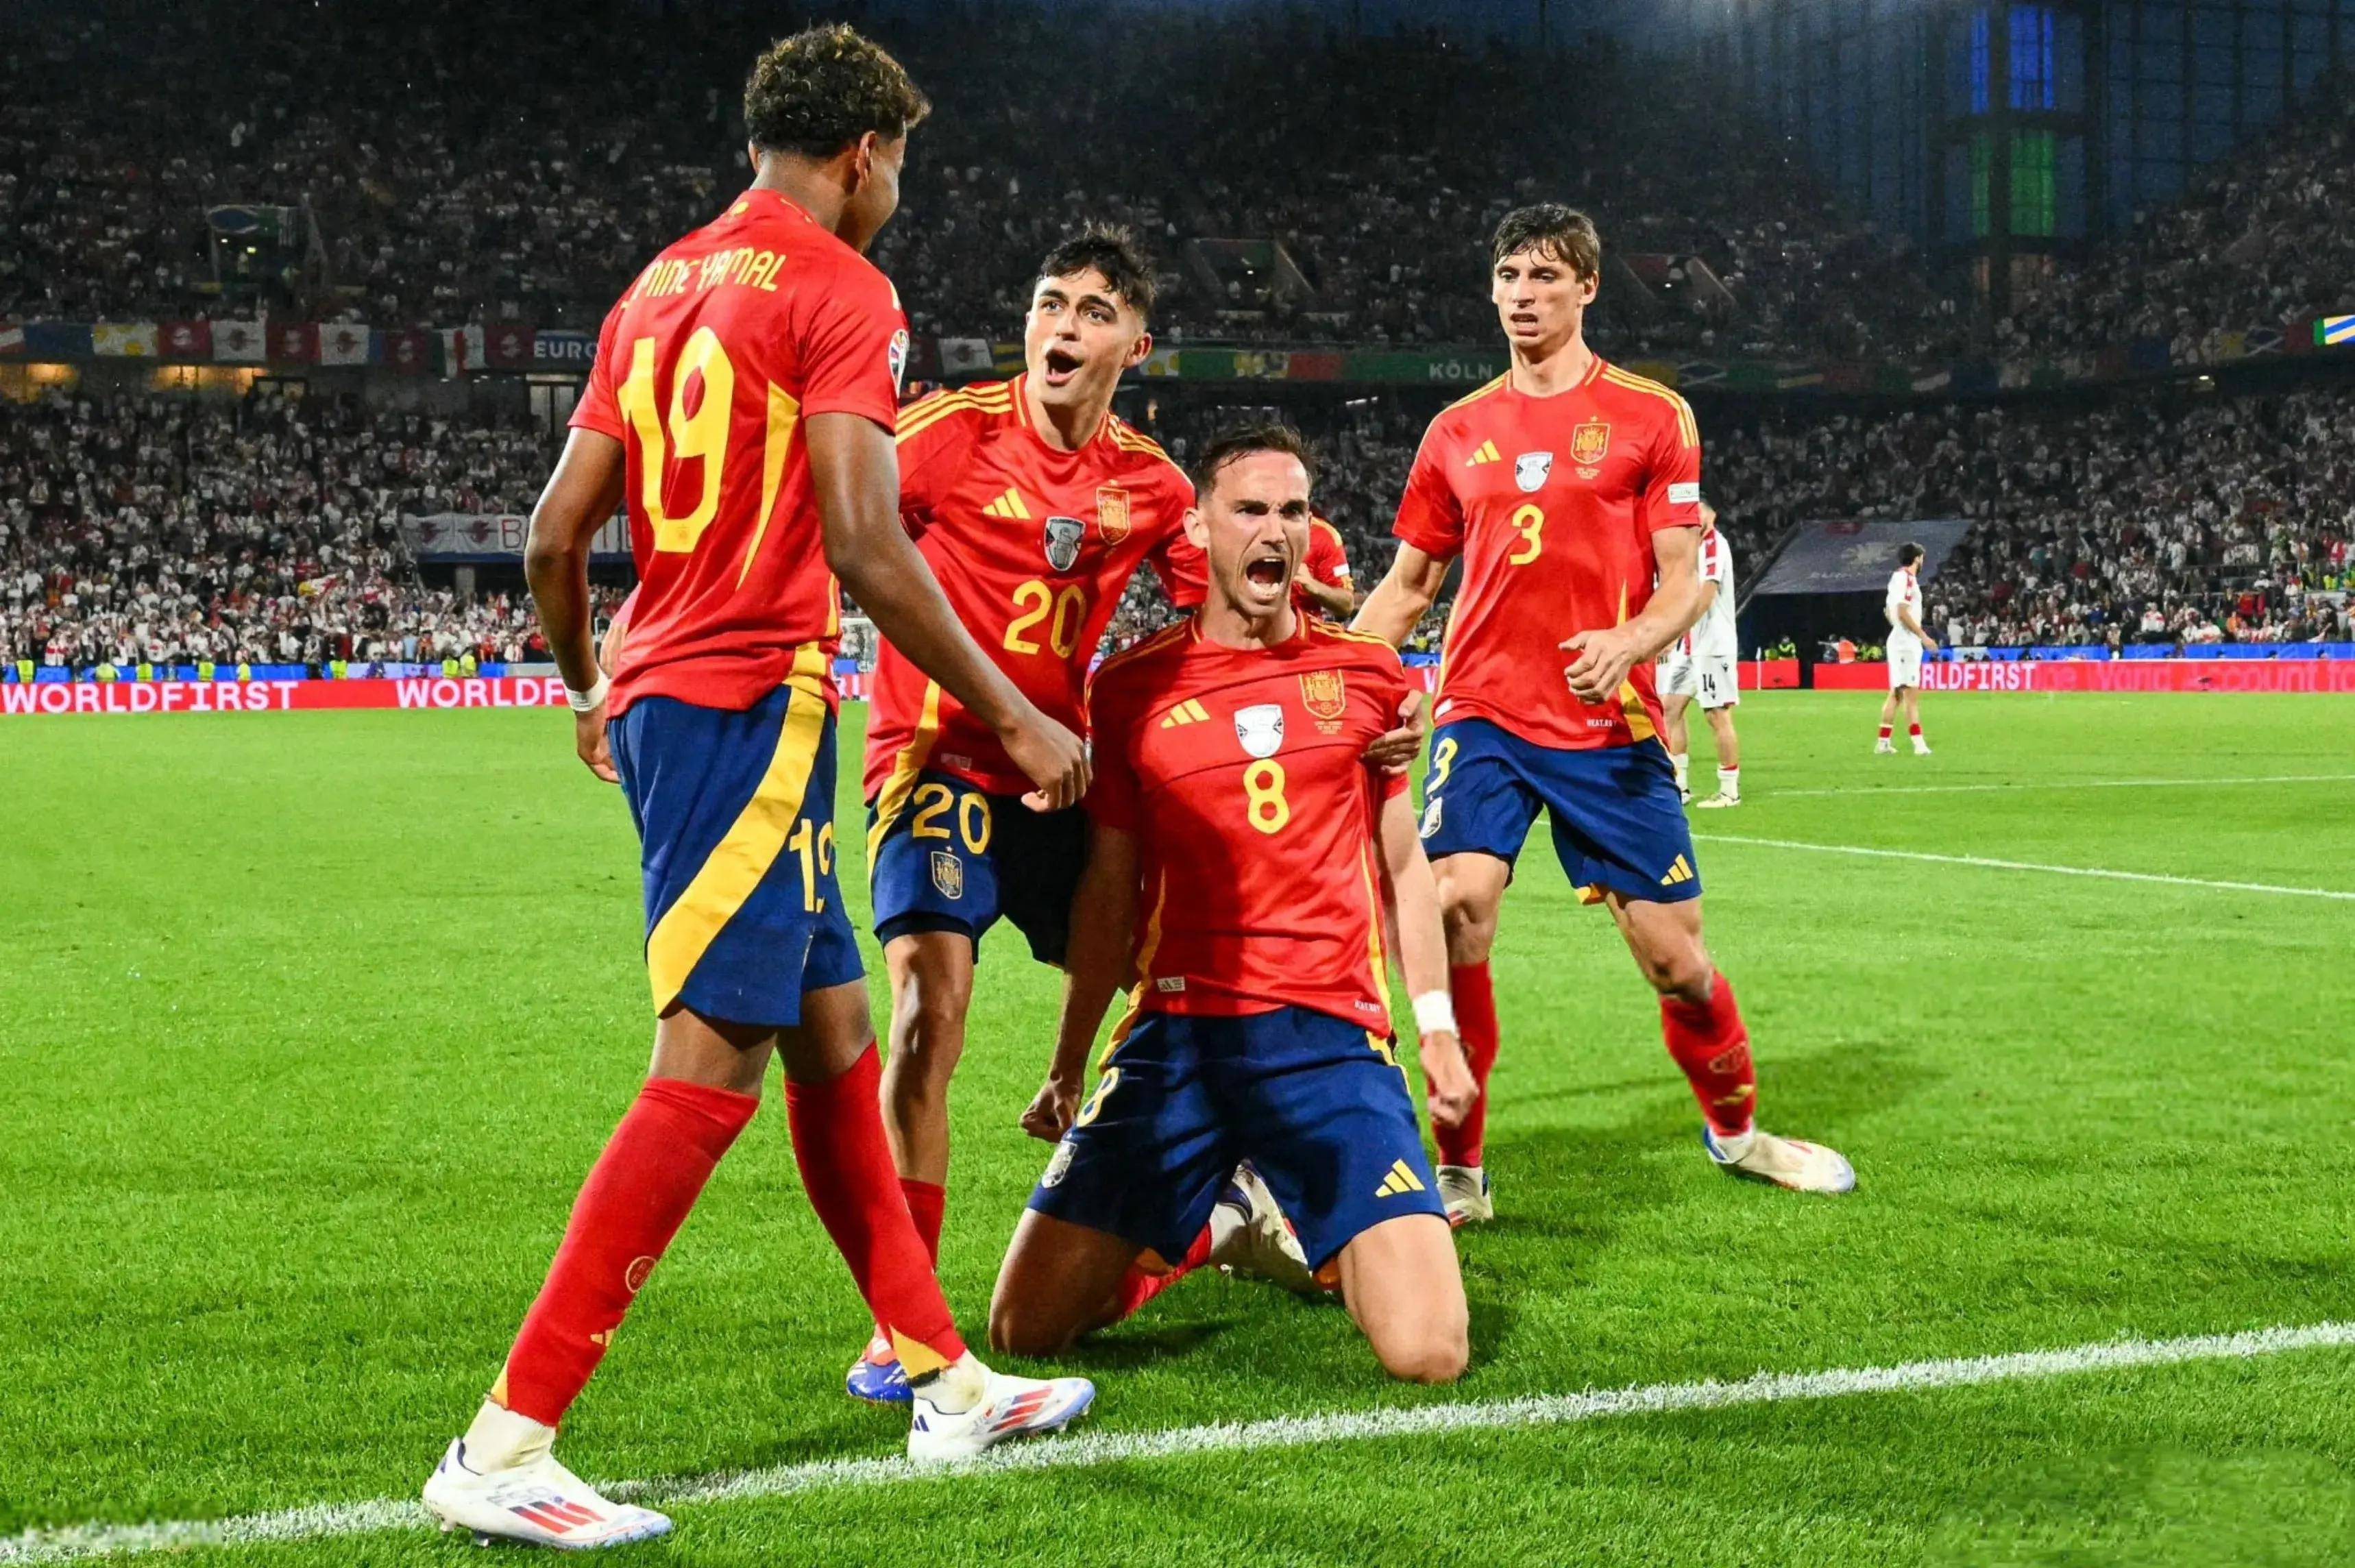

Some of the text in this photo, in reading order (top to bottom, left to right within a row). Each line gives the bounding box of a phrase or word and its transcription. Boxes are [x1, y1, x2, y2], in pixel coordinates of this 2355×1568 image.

[696, 247, 787, 293] YAMAL
[1429, 359, 1493, 380] KÖLN
[617, 326, 734, 553] 19
[1509, 504, 1545, 565] 3
[1003, 579, 1087, 659] 20
[2, 681, 300, 714] WORLDFIRST
[396, 677, 565, 709] WORLDF
[1703, 674, 1716, 692] 14
[1921, 661, 2036, 690] RLDFIRST
[1243, 758, 1291, 834] 8
[1426, 737, 1458, 796] 3
[912, 783, 992, 855] 20
[1075, 1066, 1120, 1127] 8
